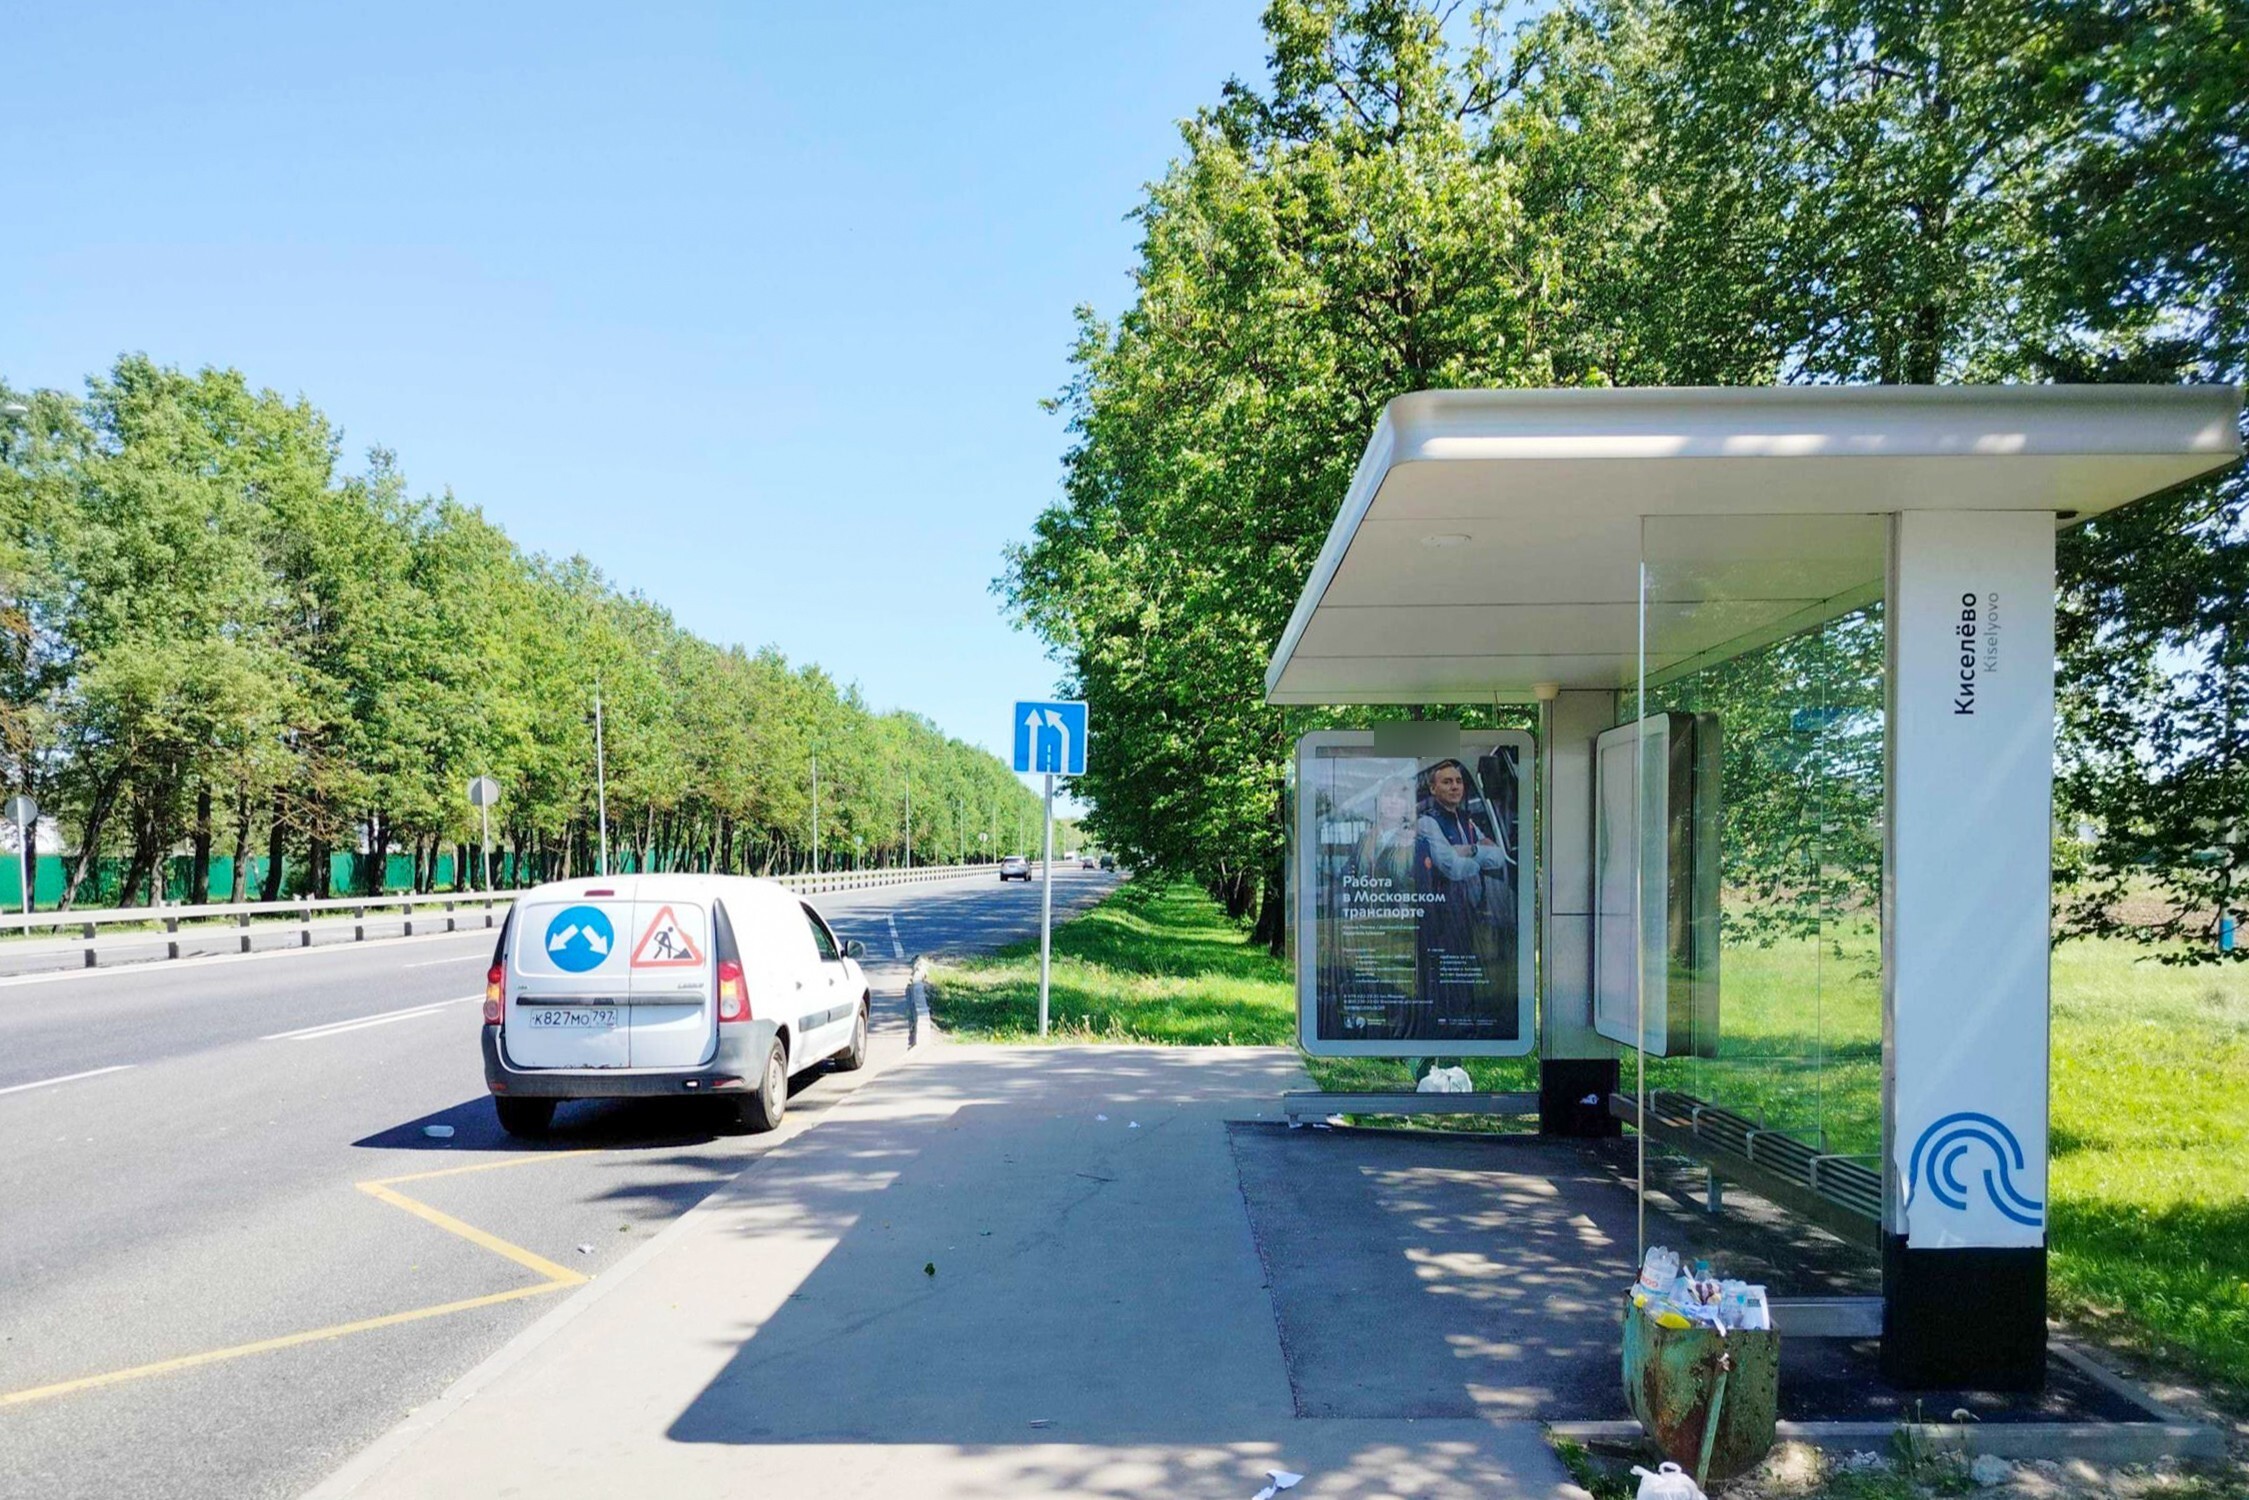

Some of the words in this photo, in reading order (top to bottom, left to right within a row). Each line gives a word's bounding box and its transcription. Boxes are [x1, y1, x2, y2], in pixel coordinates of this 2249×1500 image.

[1983, 592, 2001, 673] Kiselyovo
[1954, 592, 1977, 715] Киселёво
[1342, 874, 1392, 888] Работа
[1342, 893, 1351, 903] в
[1354, 891, 1446, 903] Московском
[1342, 907, 1425, 920] транспорте
